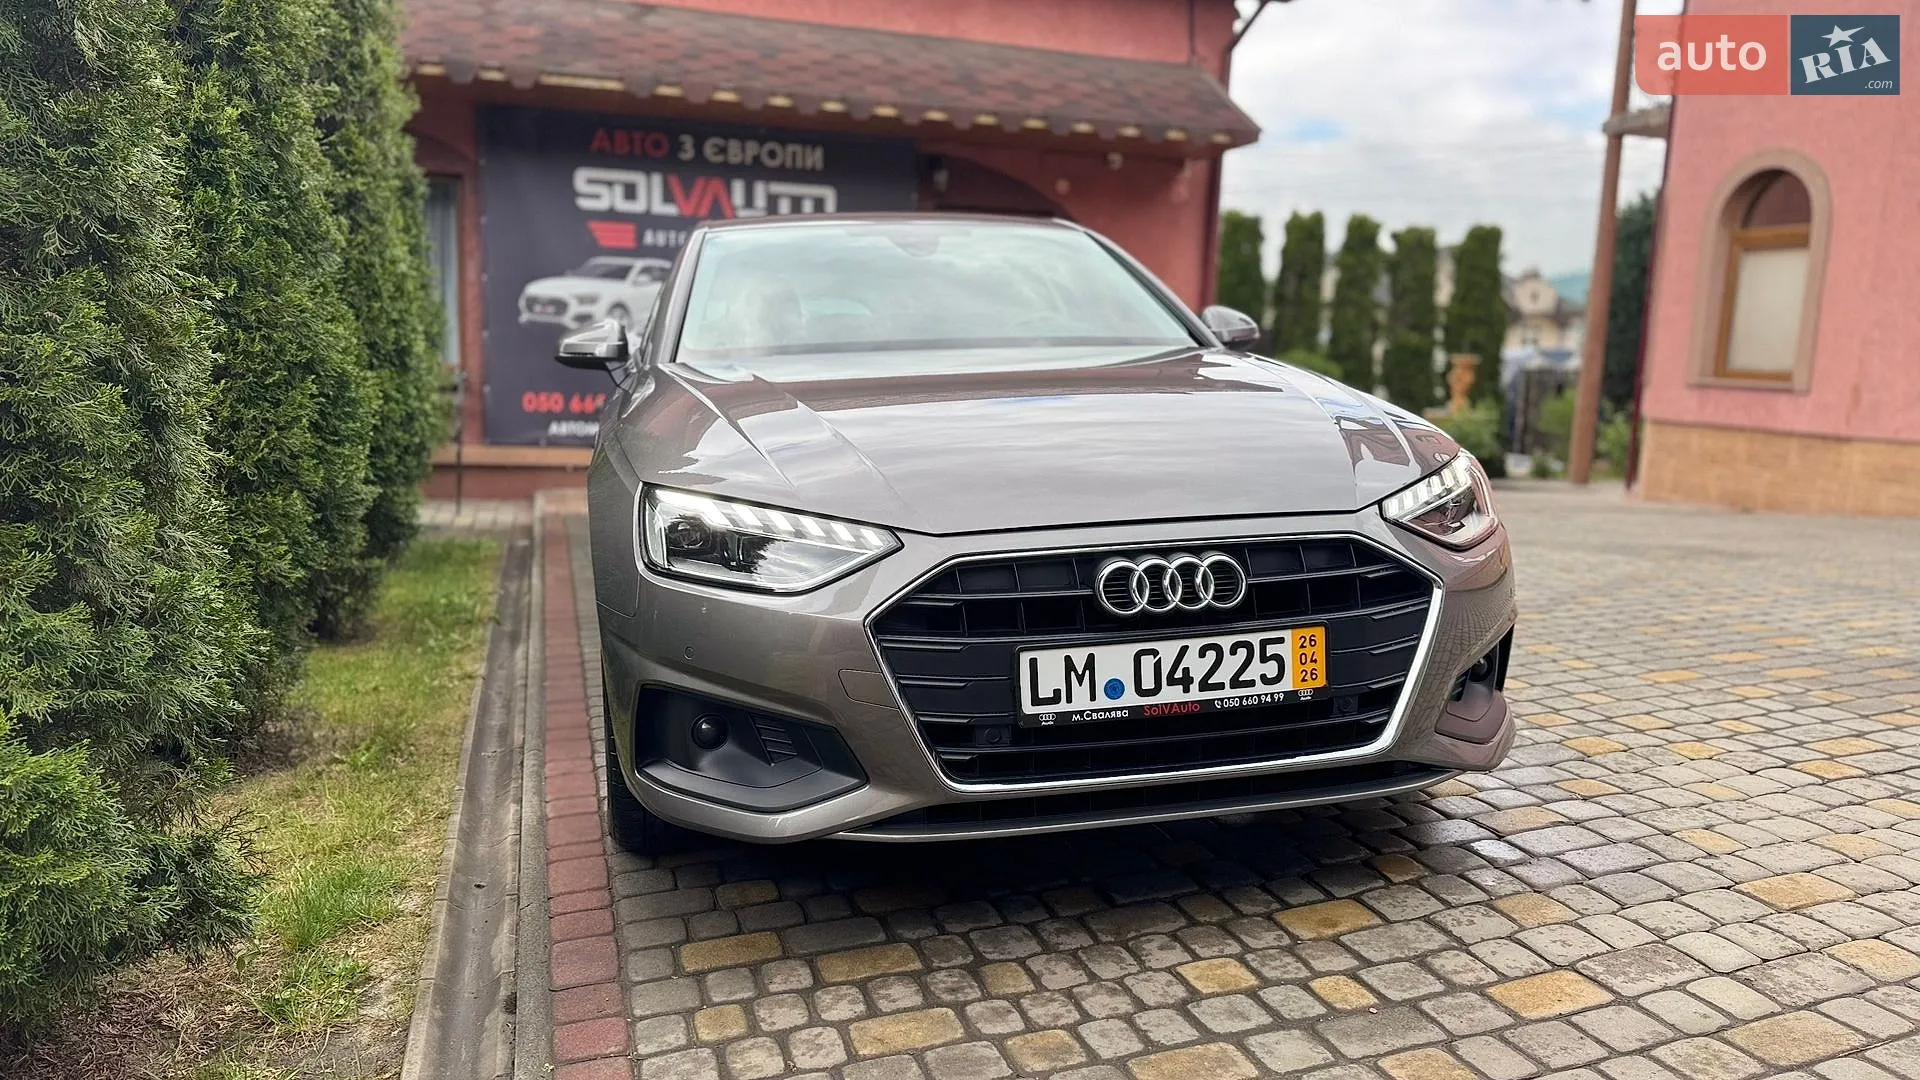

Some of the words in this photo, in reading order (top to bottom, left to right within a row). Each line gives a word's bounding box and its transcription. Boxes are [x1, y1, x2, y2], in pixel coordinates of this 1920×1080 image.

[588, 128, 670, 158] АВТО
[703, 136, 825, 171] ЄВРОПИ
[522, 390, 565, 414] 050
[1298, 634, 1317, 649] 26
[1299, 651, 1318, 666] 04
[1028, 652, 1097, 707] LM
[1133, 636, 1286, 698] 04225
[1300, 668, 1319, 683] 26
[1223, 697, 1240, 708] 050
[1242, 695, 1258, 706] 660
[1261, 693, 1272, 704] 94
[1273, 692, 1285, 702] 99
[1143, 701, 1200, 717] SolVAuto
